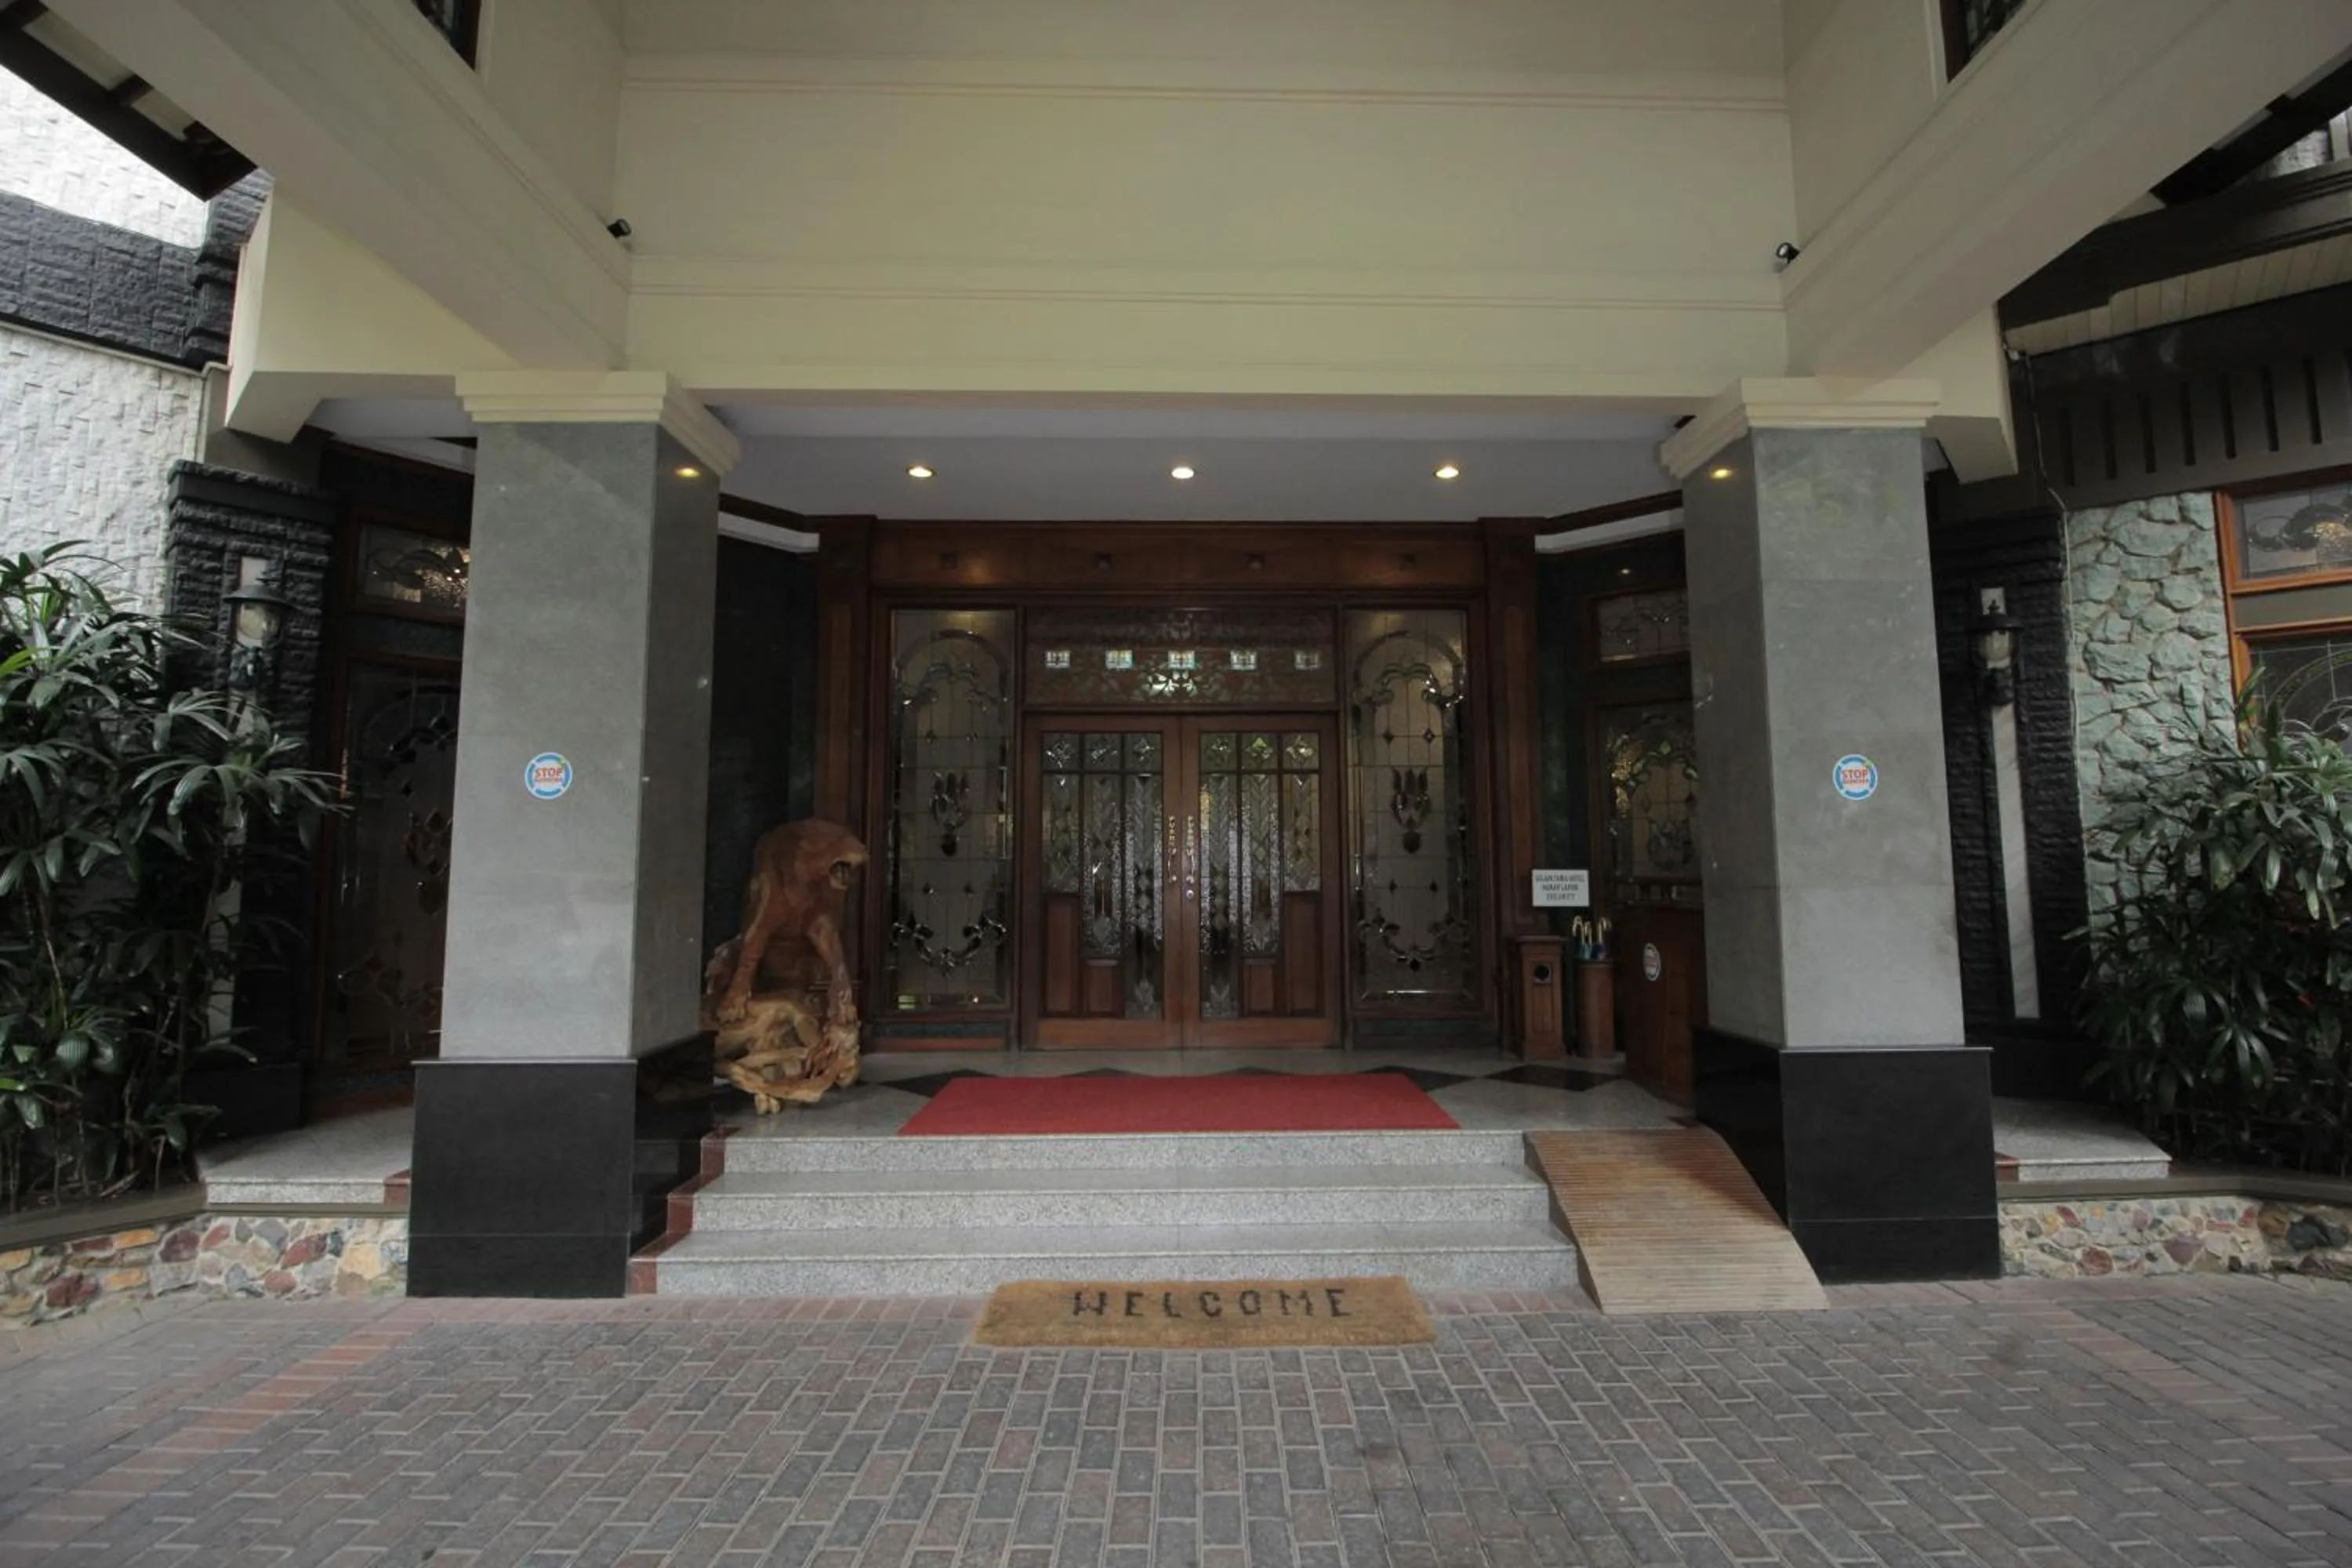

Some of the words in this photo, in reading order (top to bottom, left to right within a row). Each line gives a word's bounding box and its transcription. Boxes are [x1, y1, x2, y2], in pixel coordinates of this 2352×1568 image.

[535, 768, 563, 778] STOP
[1842, 768, 1868, 779] STOP
[1073, 1288, 1352, 1318] WELCOME
